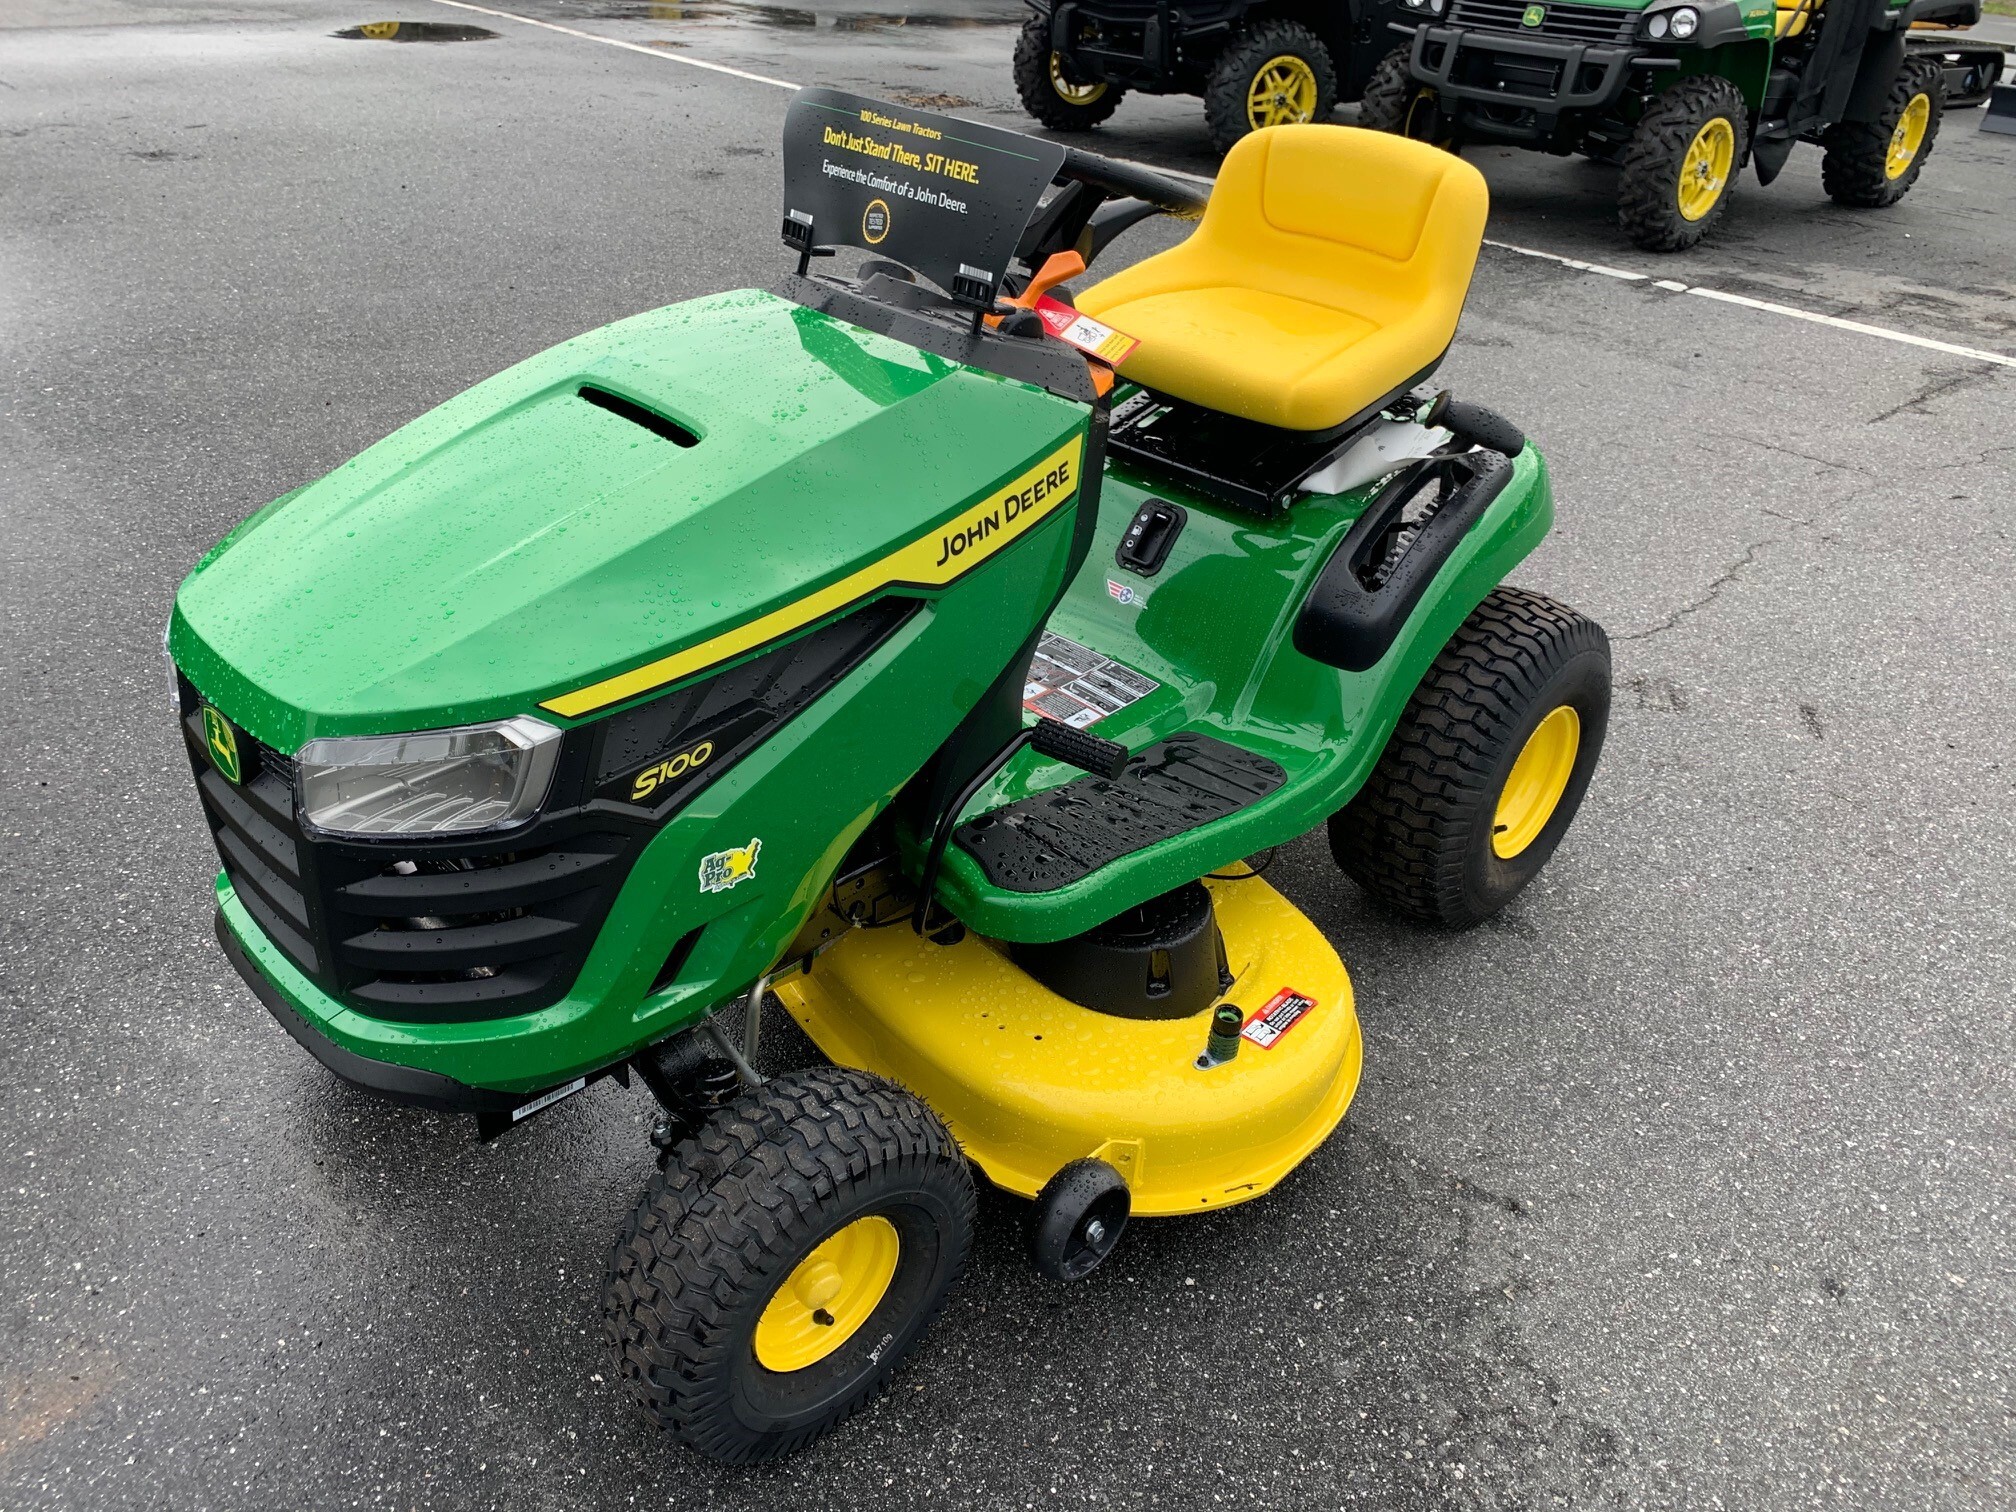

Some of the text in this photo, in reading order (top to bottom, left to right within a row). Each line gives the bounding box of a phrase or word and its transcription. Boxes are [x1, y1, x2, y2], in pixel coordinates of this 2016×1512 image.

[860, 109, 942, 140] 100 Series Lawn Tractors
[823, 126, 979, 184] Don't Just Stand There, SIT HERE.
[822, 158, 968, 214] Experience the Comfort of a John Deere.
[936, 460, 1070, 567] JOHN DEERE
[631, 741, 713, 800] S100
[703, 856, 731, 873] Ag-
[705, 868, 732, 887] Pro
